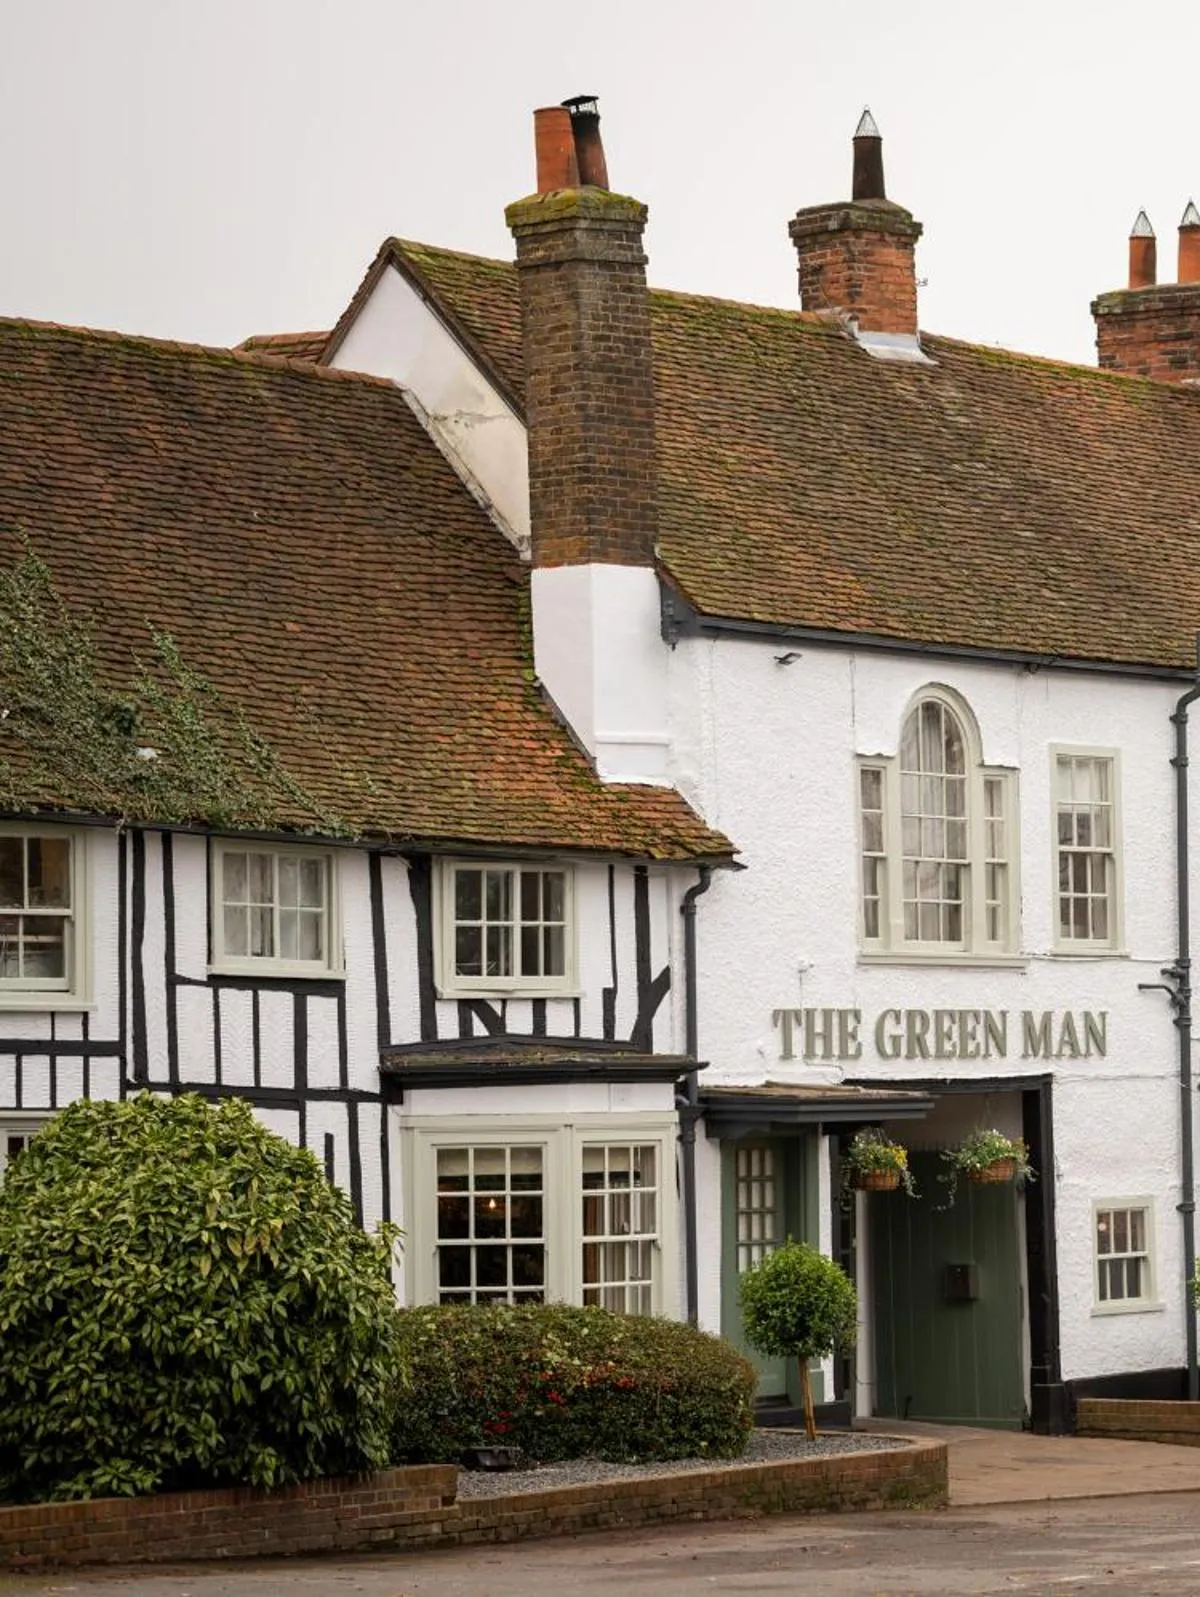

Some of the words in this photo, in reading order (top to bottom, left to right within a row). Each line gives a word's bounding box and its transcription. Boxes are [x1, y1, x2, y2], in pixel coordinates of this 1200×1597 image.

[772, 1008, 862, 1060] THE
[874, 1008, 1009, 1061] GREEN
[1020, 1010, 1109, 1059] MAN
